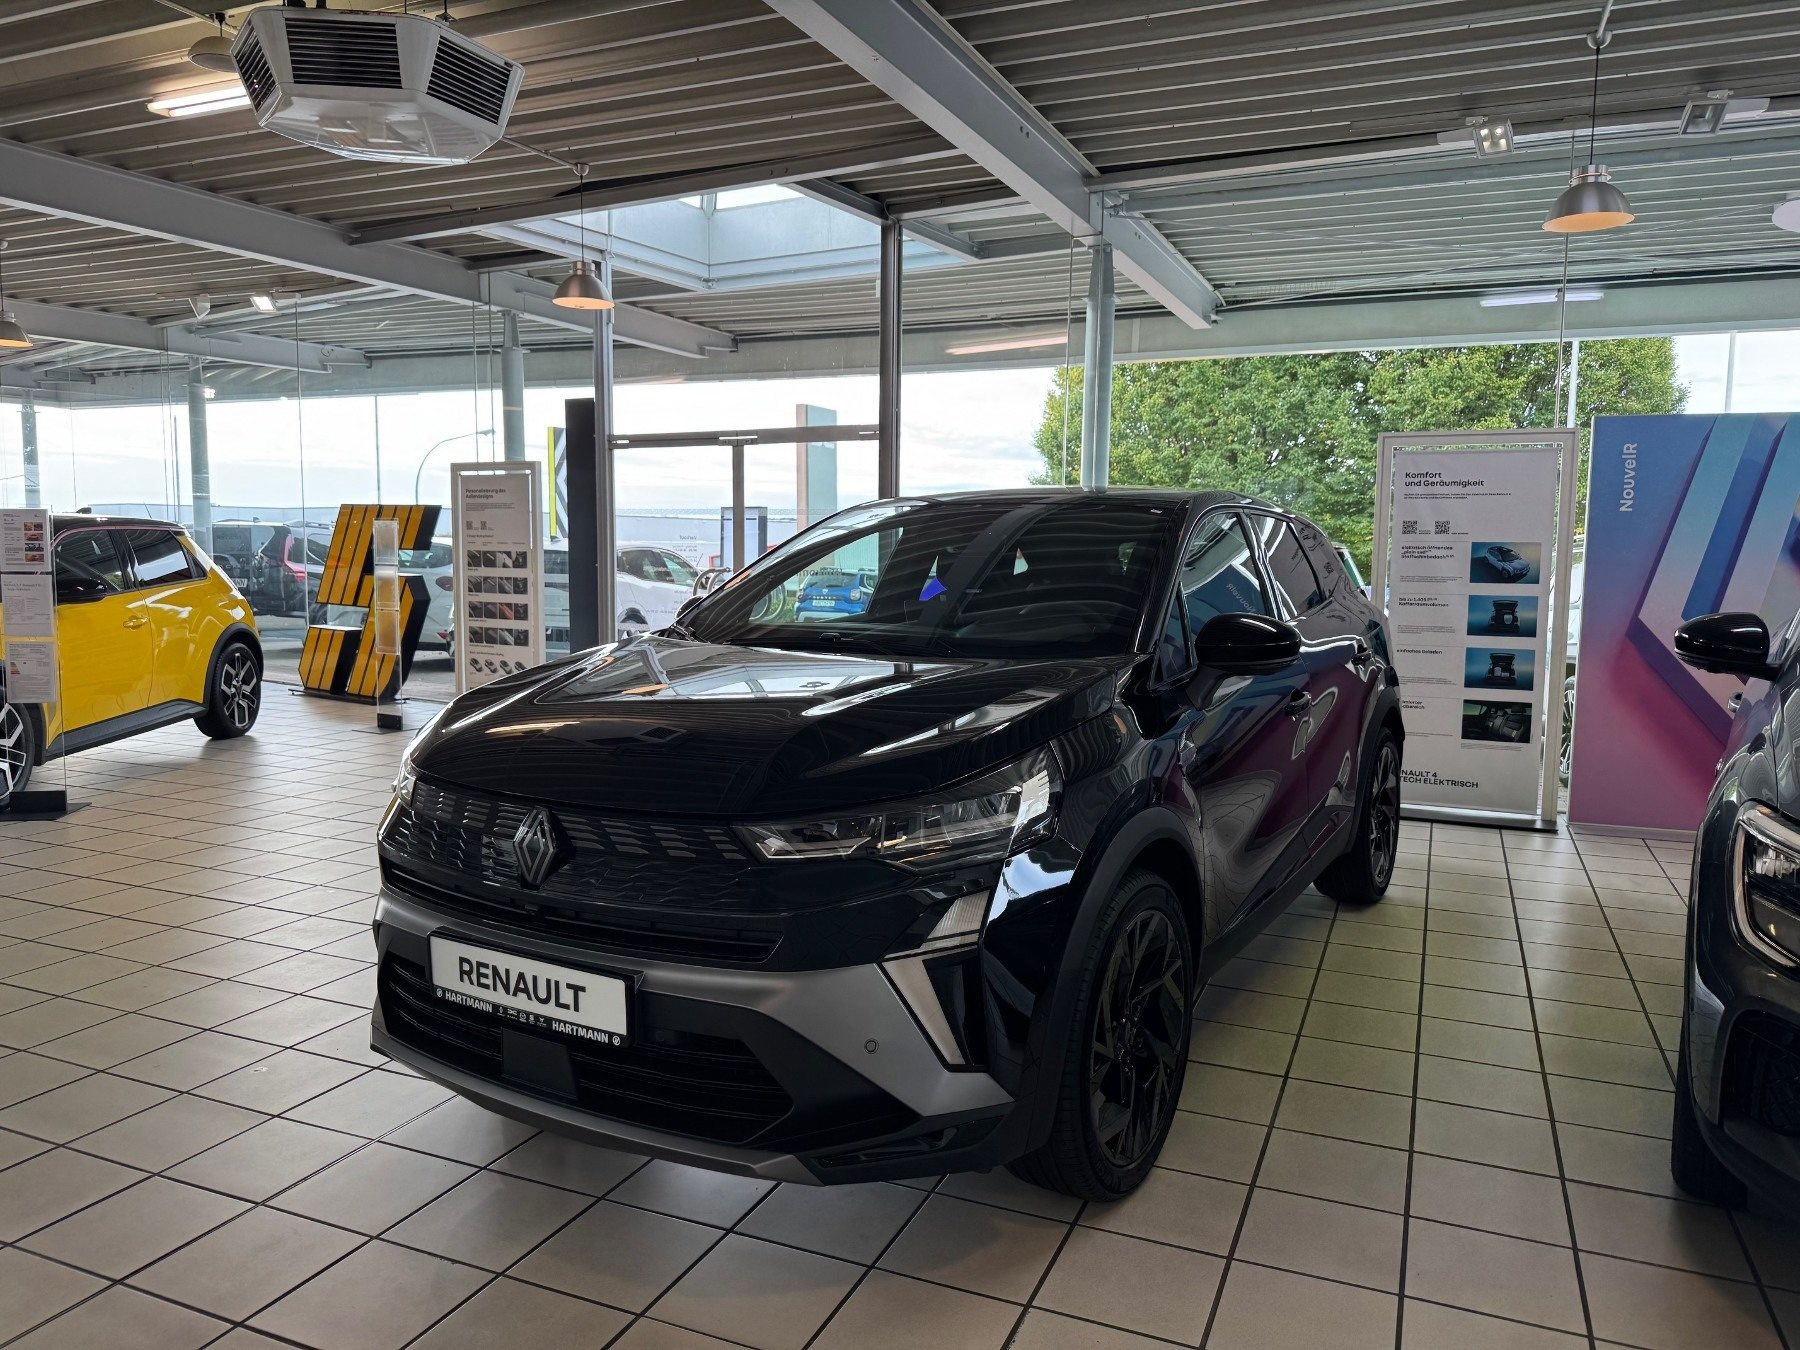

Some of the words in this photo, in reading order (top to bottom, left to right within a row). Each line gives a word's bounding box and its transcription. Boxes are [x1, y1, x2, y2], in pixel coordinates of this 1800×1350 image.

[1405, 471, 1442, 479] Komfort
[1423, 479, 1485, 488] Geräumigkeit
[1619, 443, 1638, 512] NouvelR
[1400, 769, 1431, 778] NAULT
[1423, 777, 1479, 788] ELEKTRISCH
[458, 956, 587, 1013] RENAULT
[445, 990, 493, 1013] HARTMANN
[552, 1020, 609, 1044] HARTMANN
